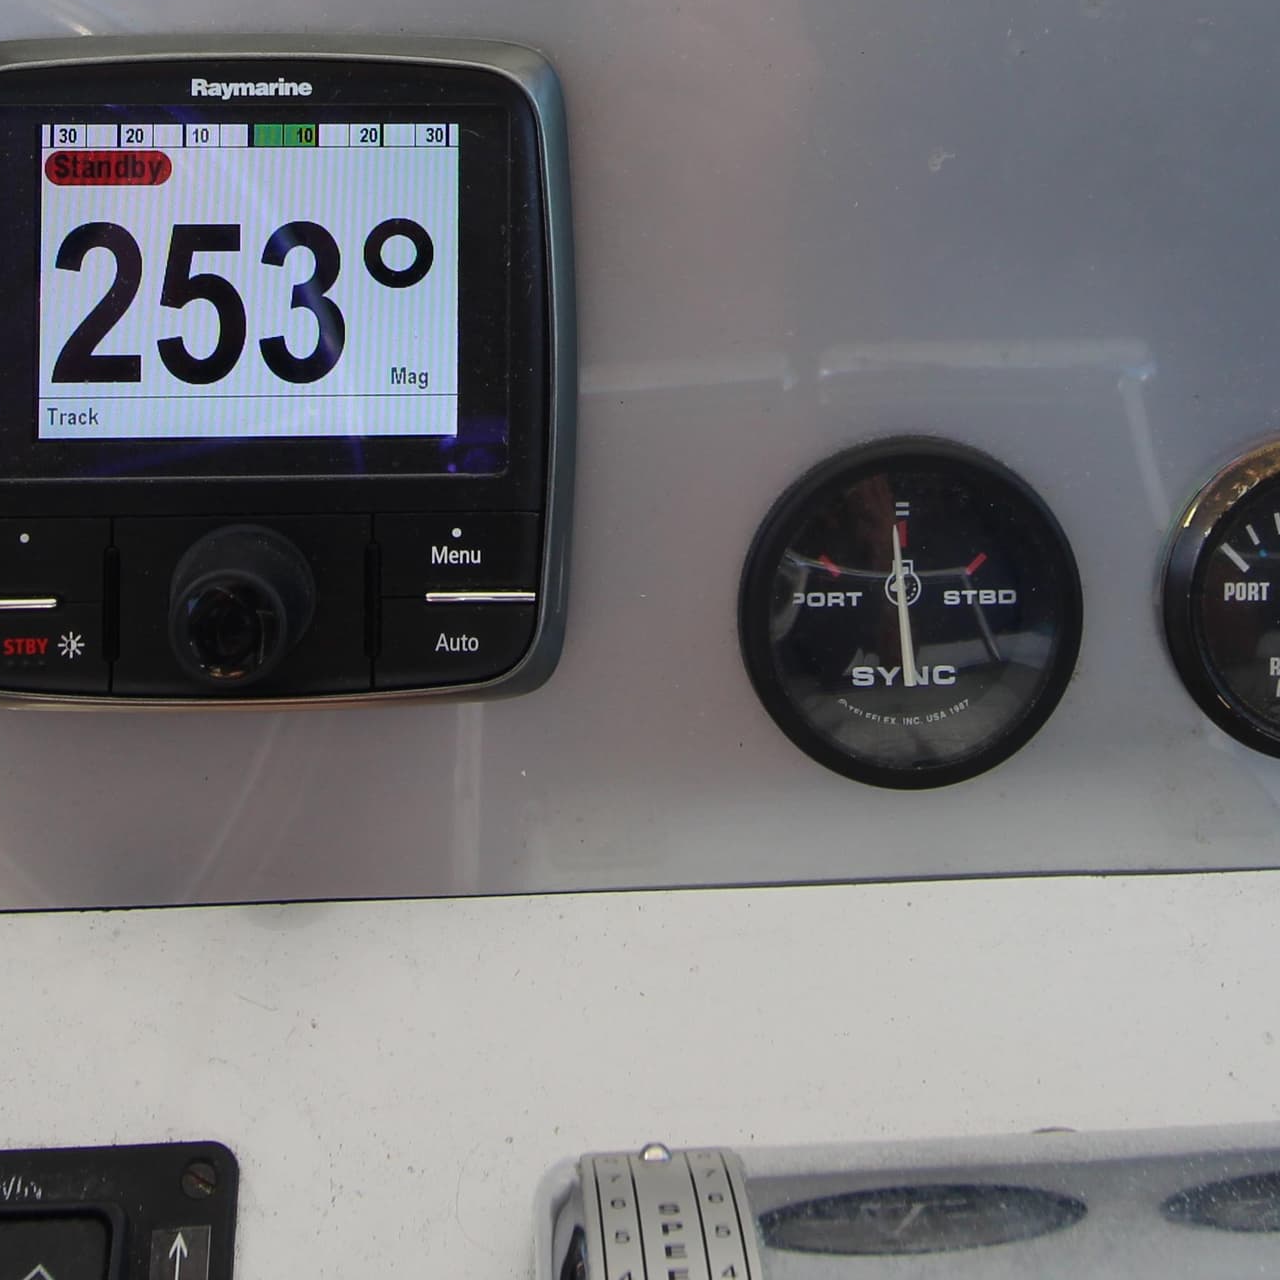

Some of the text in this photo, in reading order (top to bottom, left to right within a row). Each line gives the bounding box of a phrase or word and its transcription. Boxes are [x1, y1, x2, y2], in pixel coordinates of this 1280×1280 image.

[191, 78, 313, 100] Raymarine
[58, 128, 444, 144] 30 20 10 10 20 30
[54, 151, 163, 184] Standby
[391, 366, 429, 389] Mag
[47, 407, 99, 427] Track
[431, 545, 481, 565] Menu
[943, 589, 1017, 605] STBD
[1224, 582, 1270, 601] PORT
[3, 637, 49, 656] STBY
[436, 632, 479, 652] Auto
[852, 665, 956, 687] SYNC
[926, 711, 947, 723] USA
